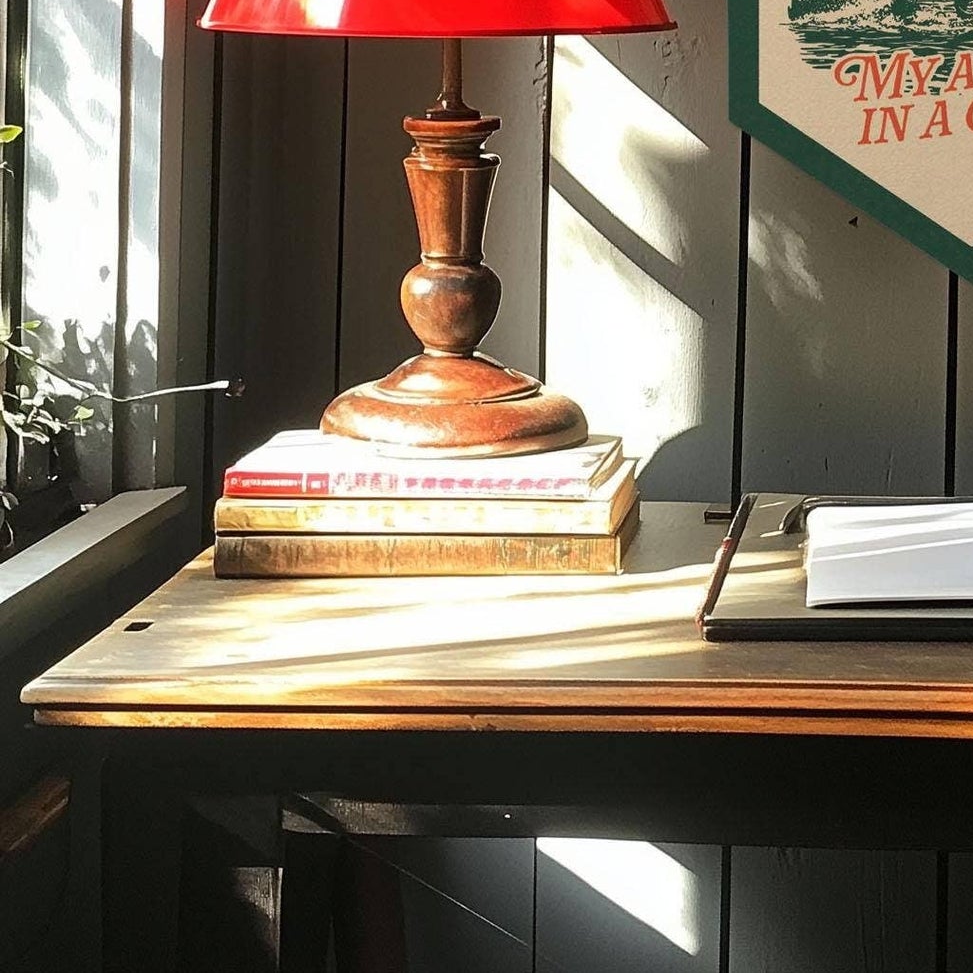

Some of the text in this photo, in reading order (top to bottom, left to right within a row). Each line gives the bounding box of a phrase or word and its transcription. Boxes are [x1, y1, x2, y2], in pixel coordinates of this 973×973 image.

[833, 51, 941, 102] MY
[857, 104, 915, 145] IN
[919, 100, 952, 139] A
